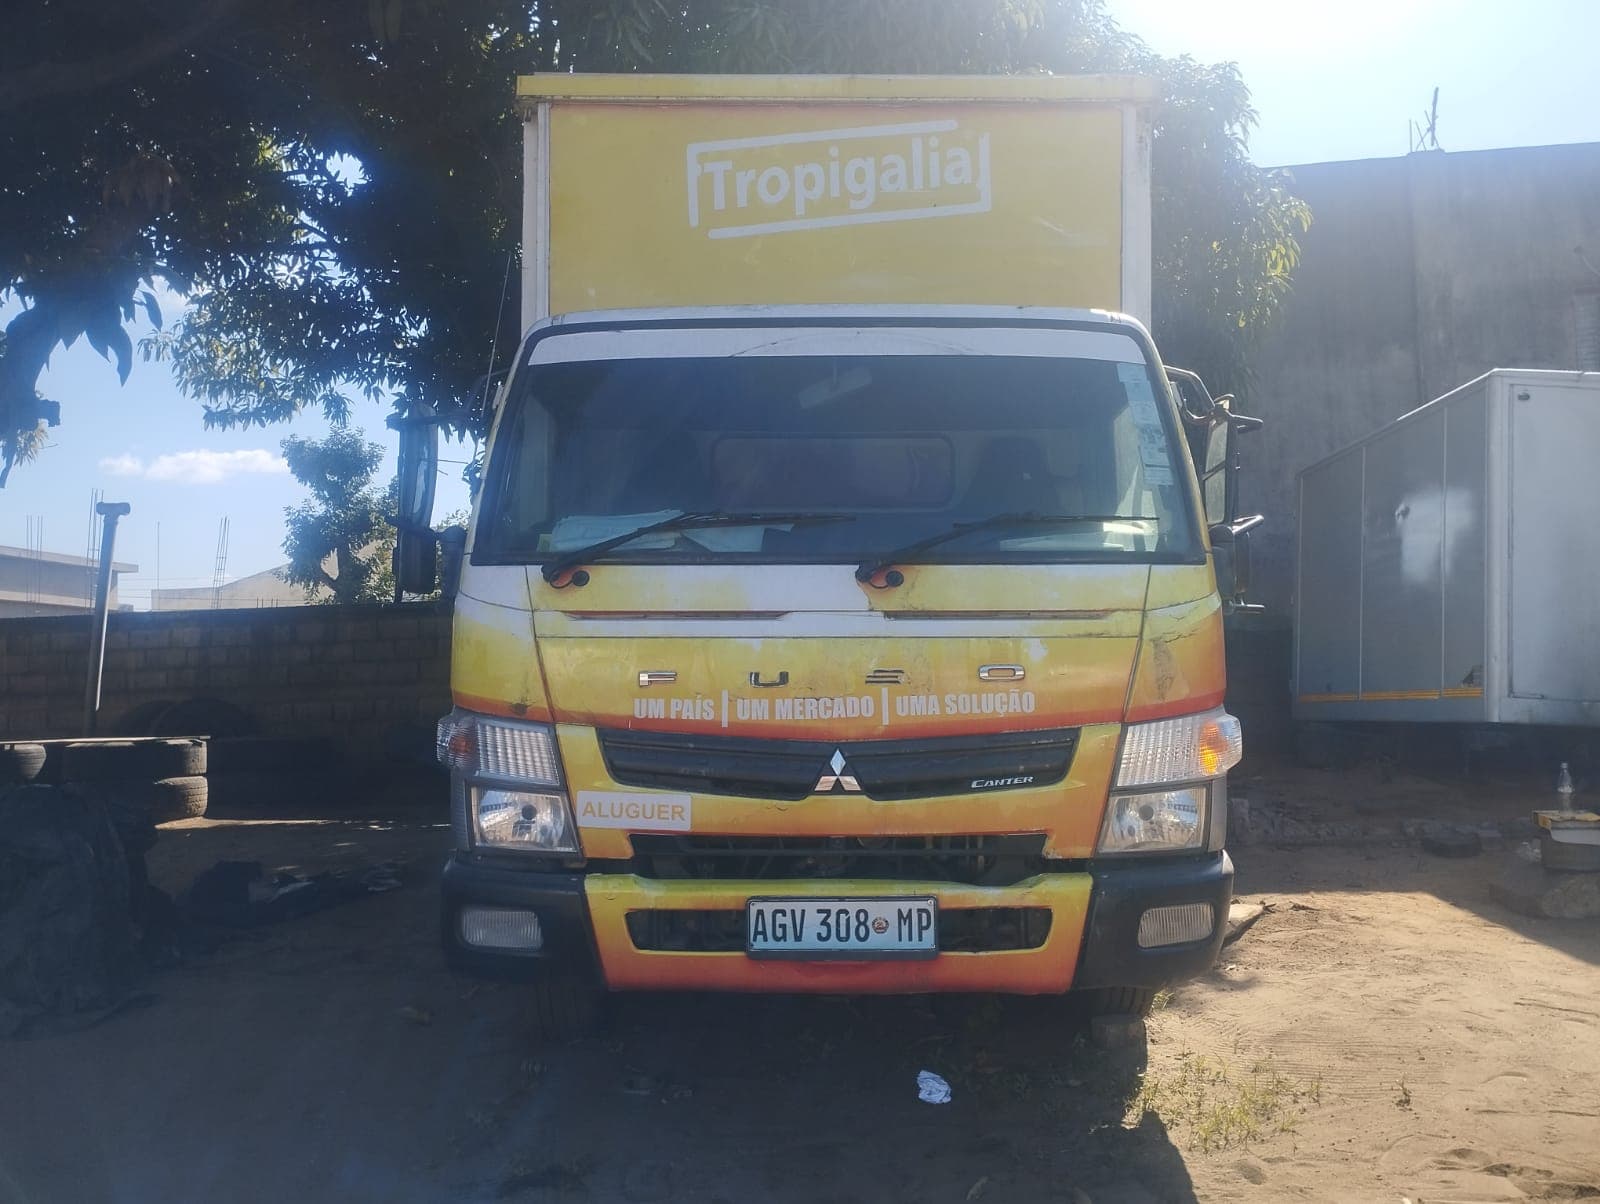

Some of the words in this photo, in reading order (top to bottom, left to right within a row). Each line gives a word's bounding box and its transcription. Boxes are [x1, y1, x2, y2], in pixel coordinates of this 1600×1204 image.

[702, 135, 973, 216] Tropigalia
[638, 664, 1026, 688] FUSO
[633, 698, 665, 719] UM
[670, 694, 715, 720] PAÍS
[736, 698, 769, 720] UM
[775, 695, 875, 721] MERCADO
[896, 695, 941, 717] UMA
[945, 689, 1036, 717] SOLUÇÃO
[582, 800, 686, 821] ALUGUER
[752, 908, 806, 943] AGV
[816, 908, 870, 943] 308
[897, 907, 932, 942] MP
